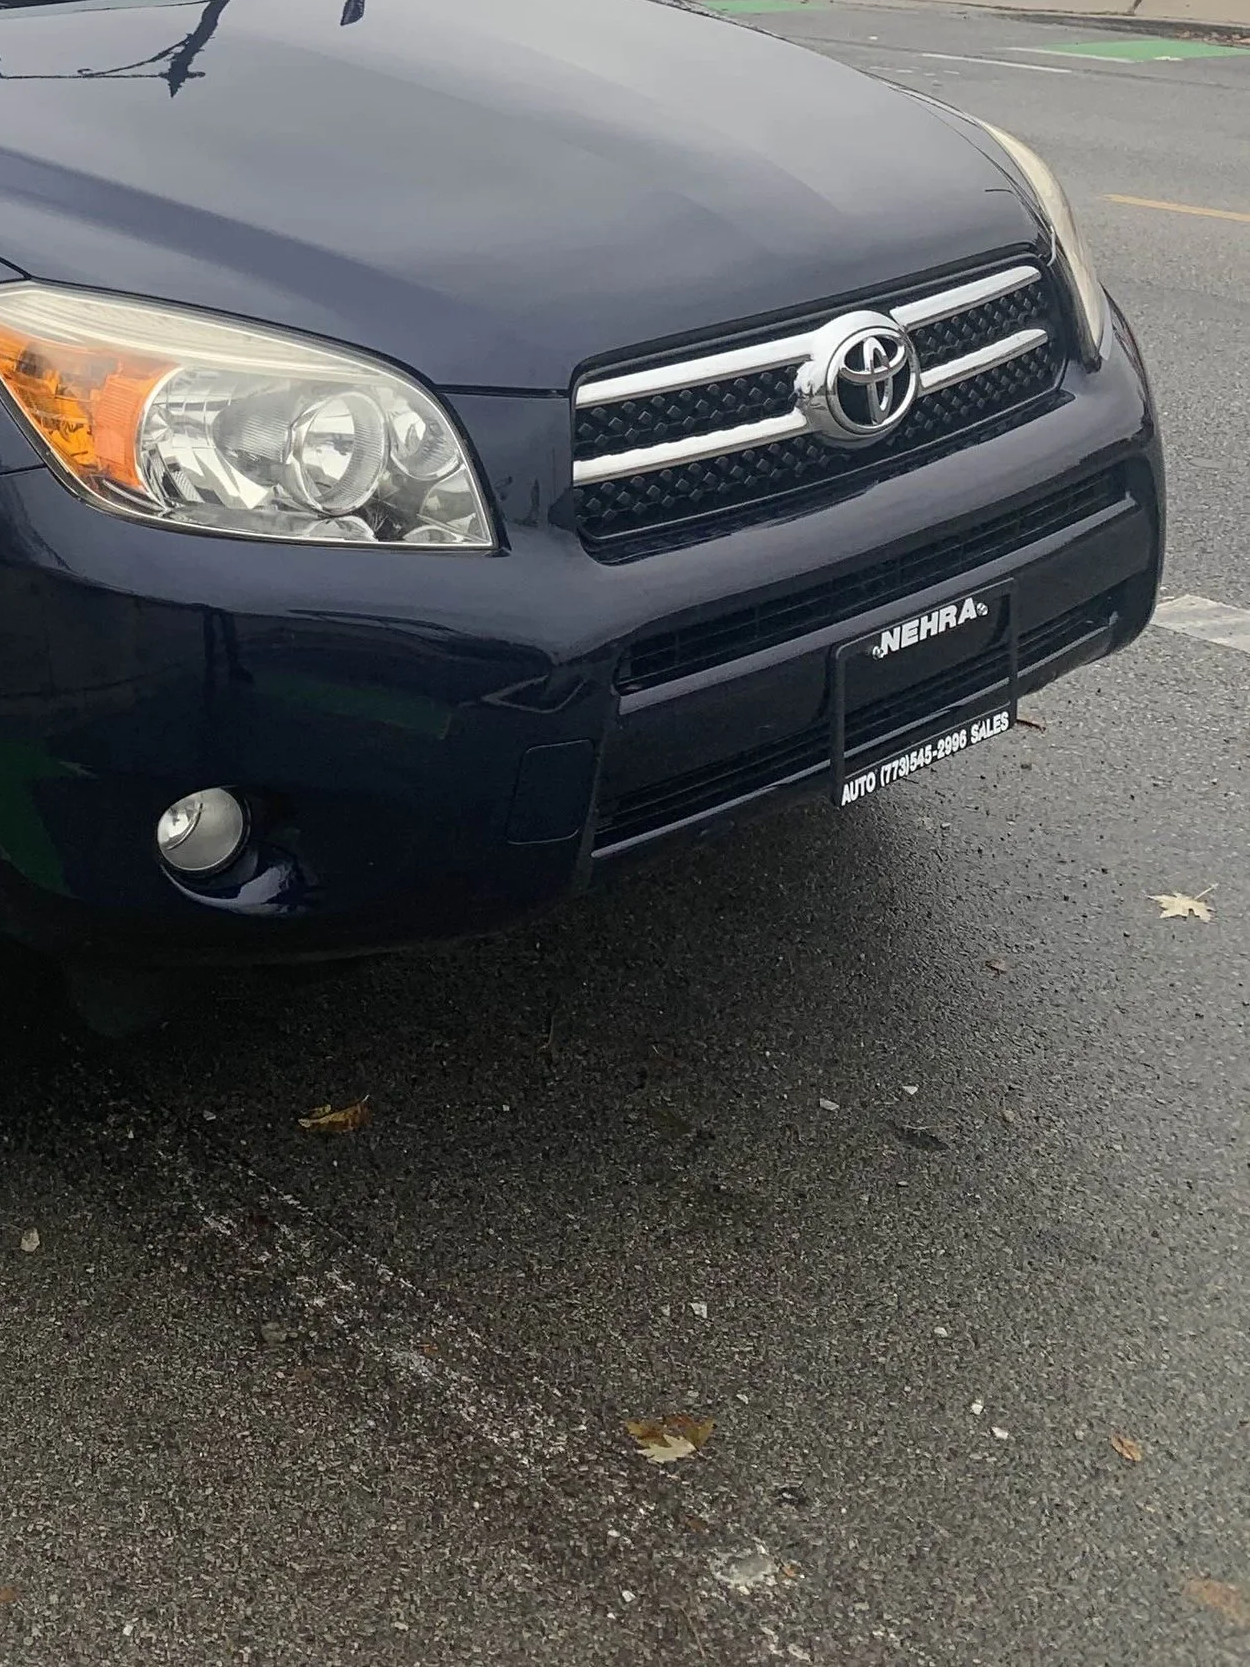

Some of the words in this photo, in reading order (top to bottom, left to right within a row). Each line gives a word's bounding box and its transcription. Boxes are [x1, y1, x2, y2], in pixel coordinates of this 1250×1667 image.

[880, 597, 977, 656] NEHRA
[841, 771, 876, 806] AUTO
[879, 729, 967, 787] (773)545-2996
[970, 711, 1009, 744] SALES
